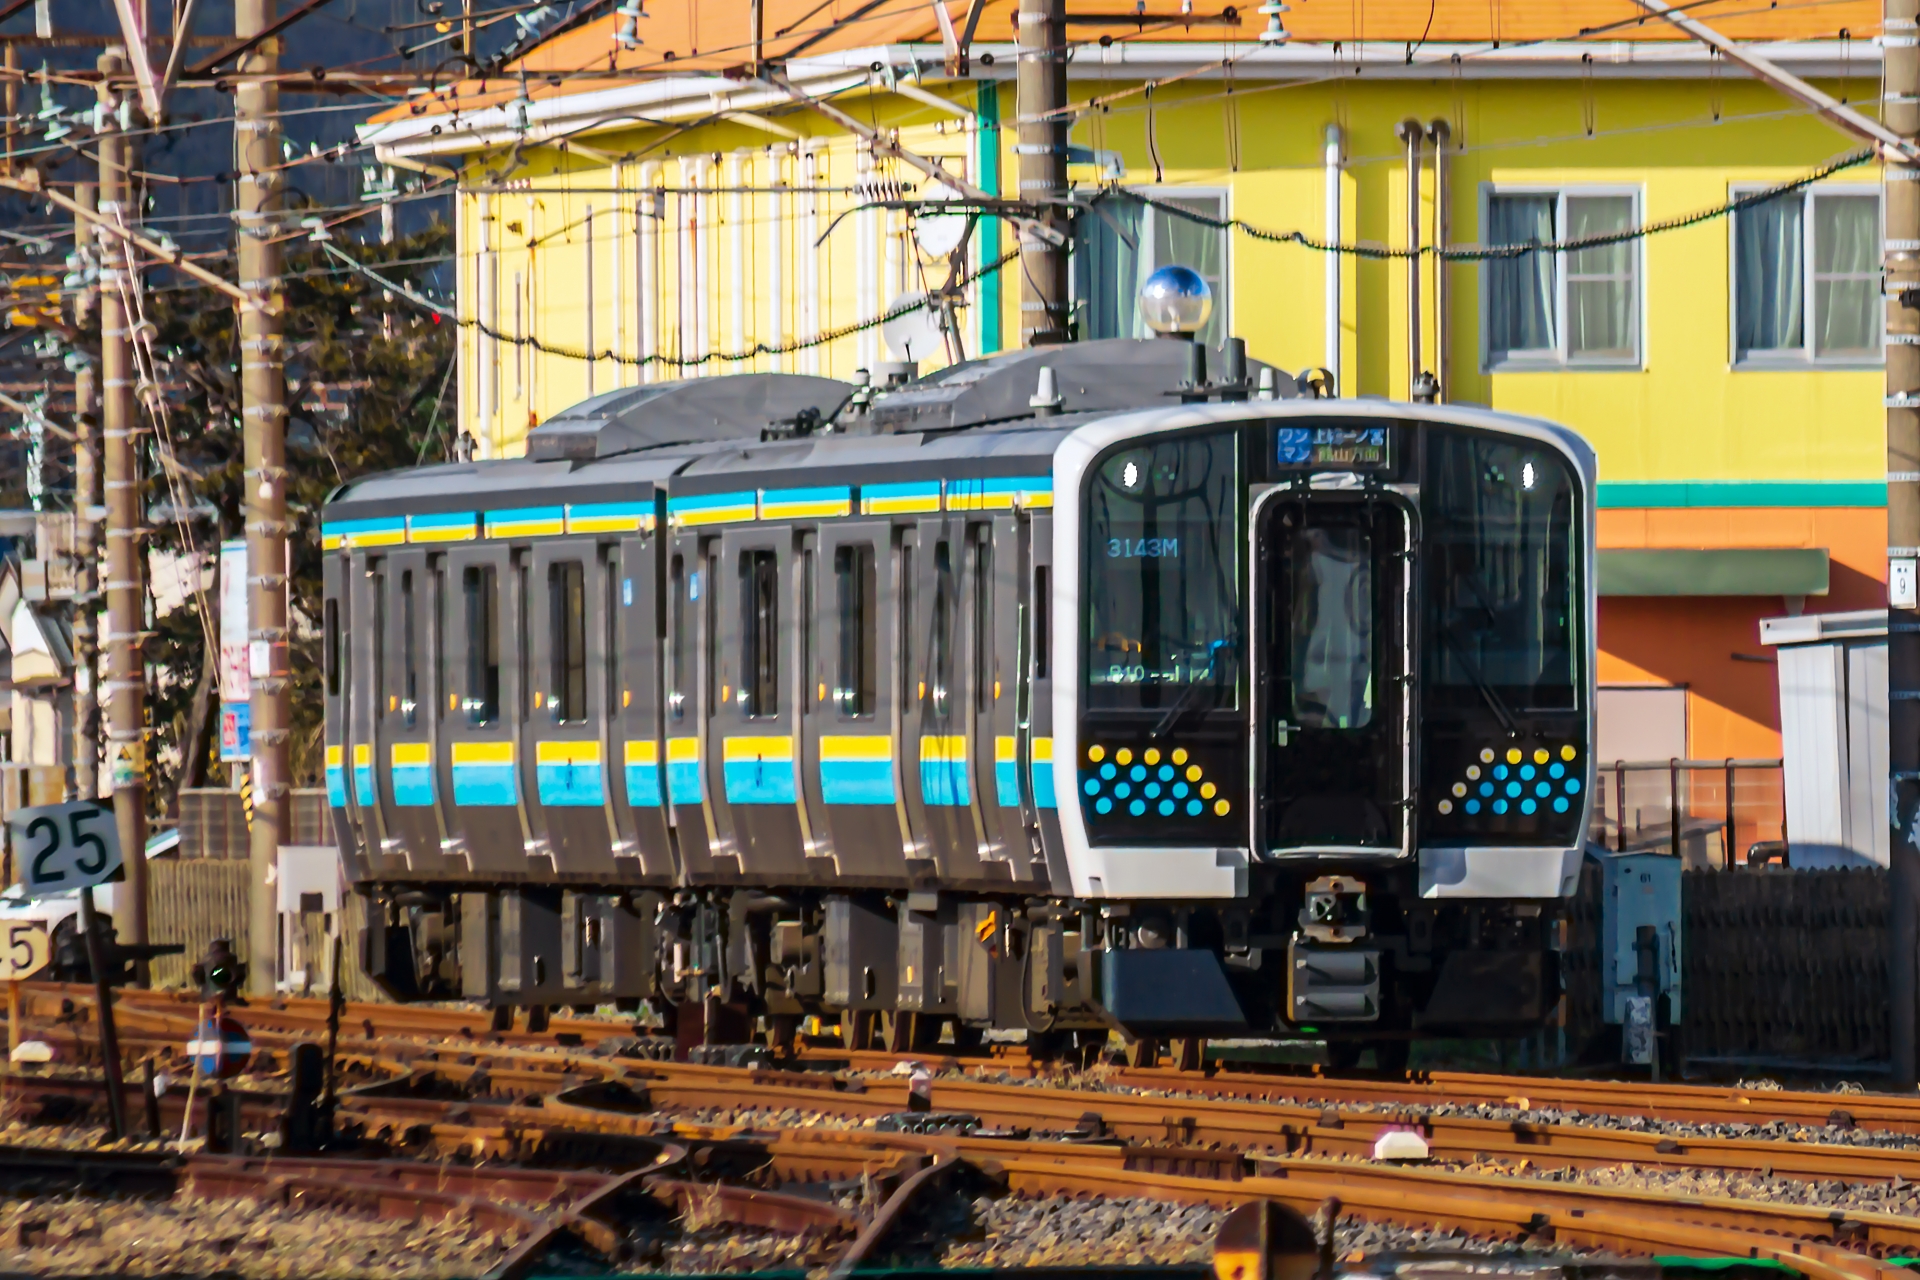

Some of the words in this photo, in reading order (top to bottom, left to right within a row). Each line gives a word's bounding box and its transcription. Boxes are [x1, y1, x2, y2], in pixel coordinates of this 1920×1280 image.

[1279, 428, 1308, 444] ワン
[1283, 446, 1311, 462] マン
[1107, 537, 1178, 558] 3143M
[26, 809, 107, 884] 25
[0, 926, 33, 970] 5
